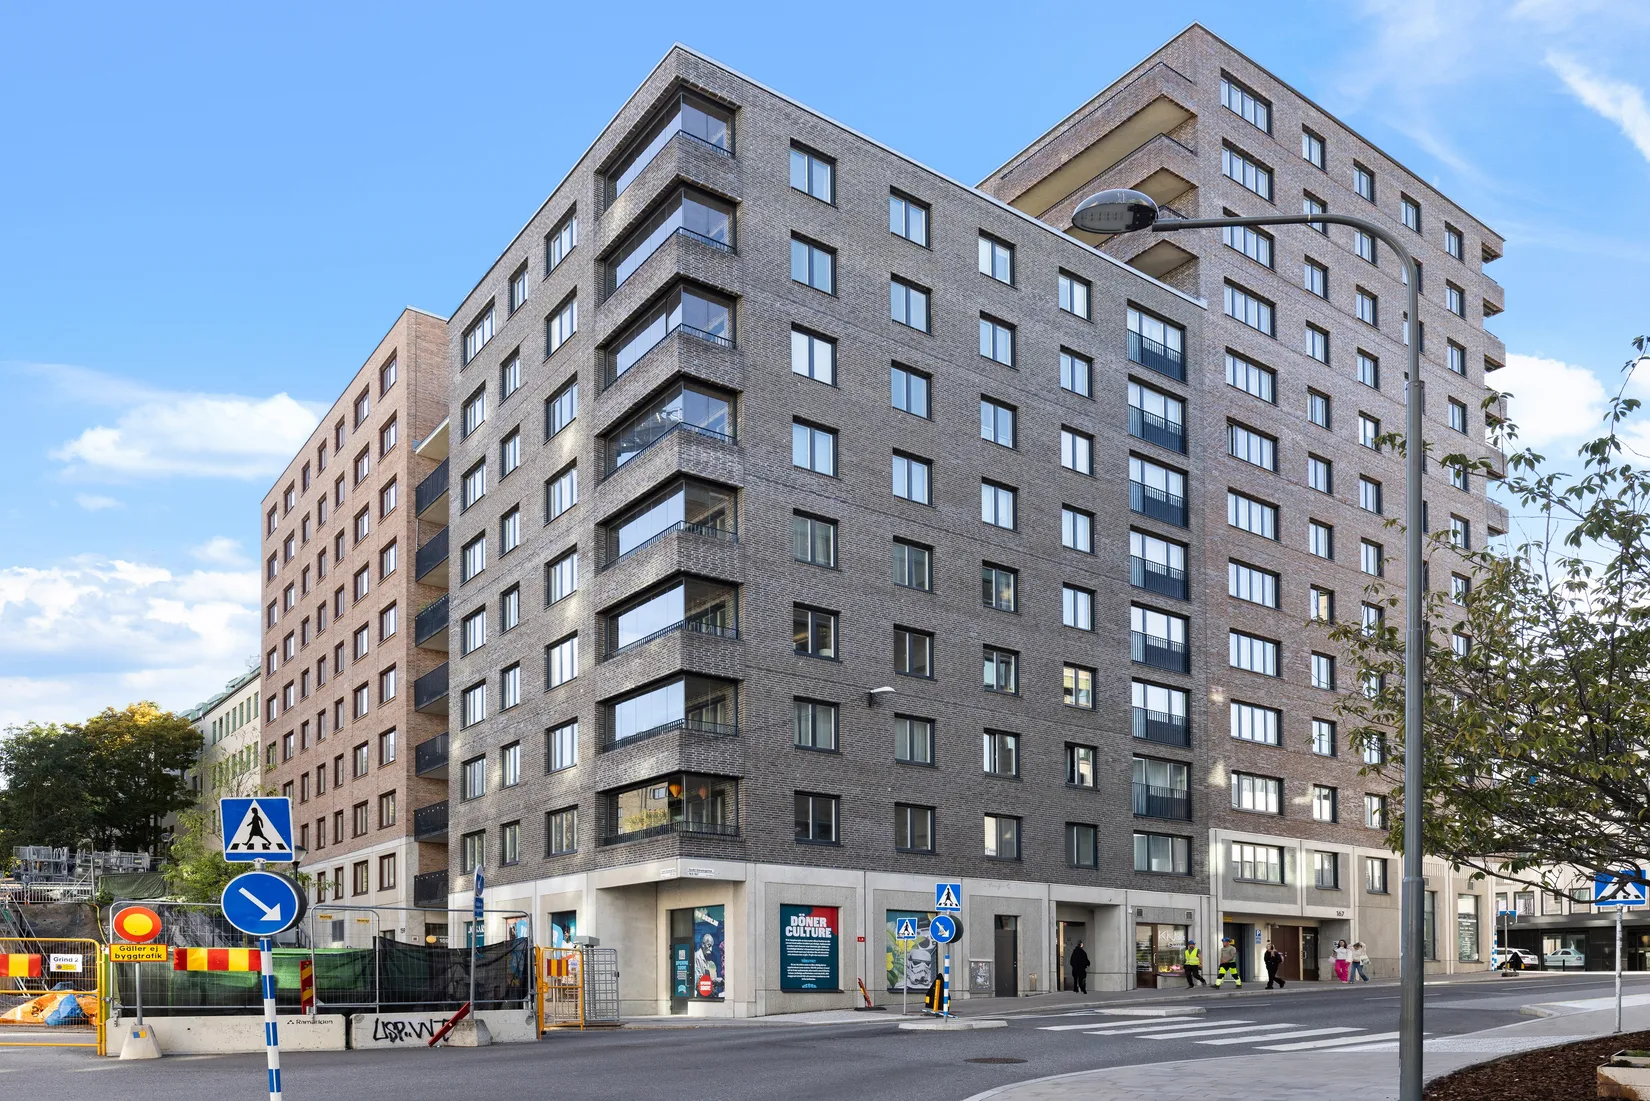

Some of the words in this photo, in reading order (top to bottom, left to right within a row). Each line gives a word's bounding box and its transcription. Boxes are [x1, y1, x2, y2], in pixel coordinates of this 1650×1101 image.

[790, 913, 827, 928] DÖNER
[785, 926, 832, 938] CULTURE
[149, 945, 158, 953] ej
